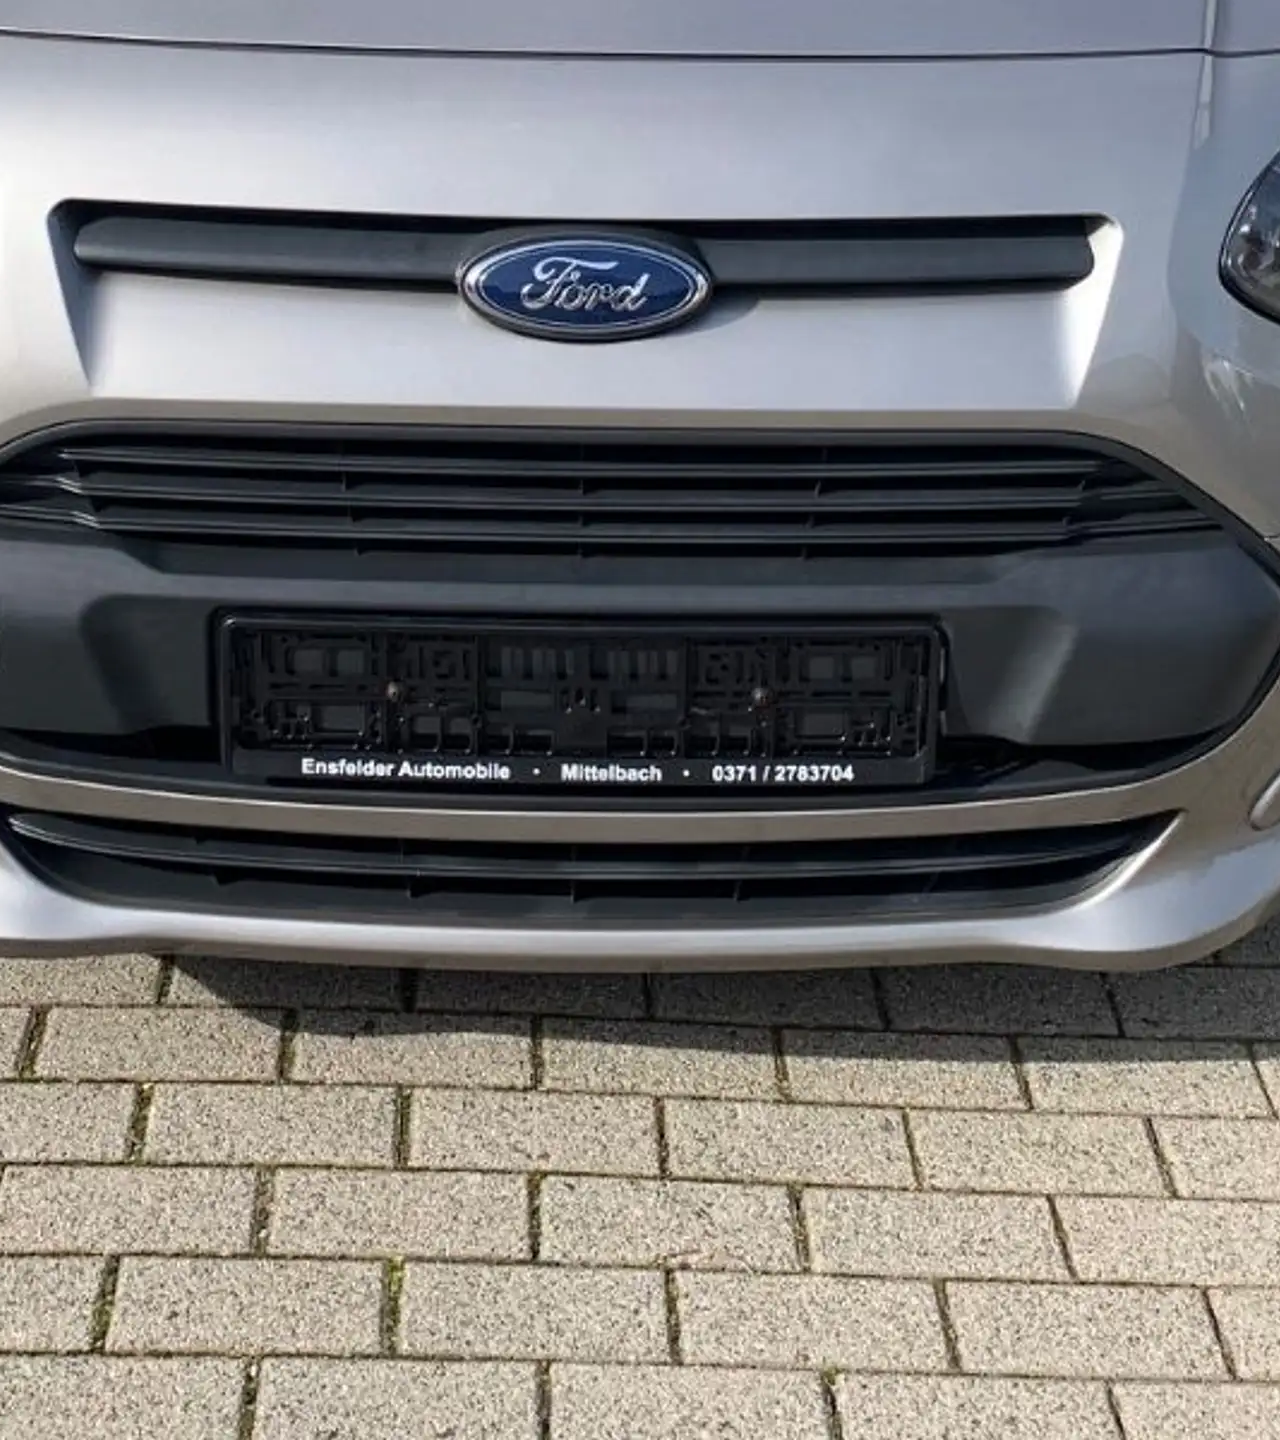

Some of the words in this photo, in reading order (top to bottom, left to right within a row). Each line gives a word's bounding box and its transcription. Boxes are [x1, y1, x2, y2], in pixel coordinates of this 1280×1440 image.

[520, 256, 651, 311] Ford
[301, 757, 395, 777] Ensfelder
[398, 760, 511, 780] Automobile
[560, 762, 662, 782] Mittelbach
[712, 763, 757, 782] 0371
[774, 763, 856, 782] 2783704
